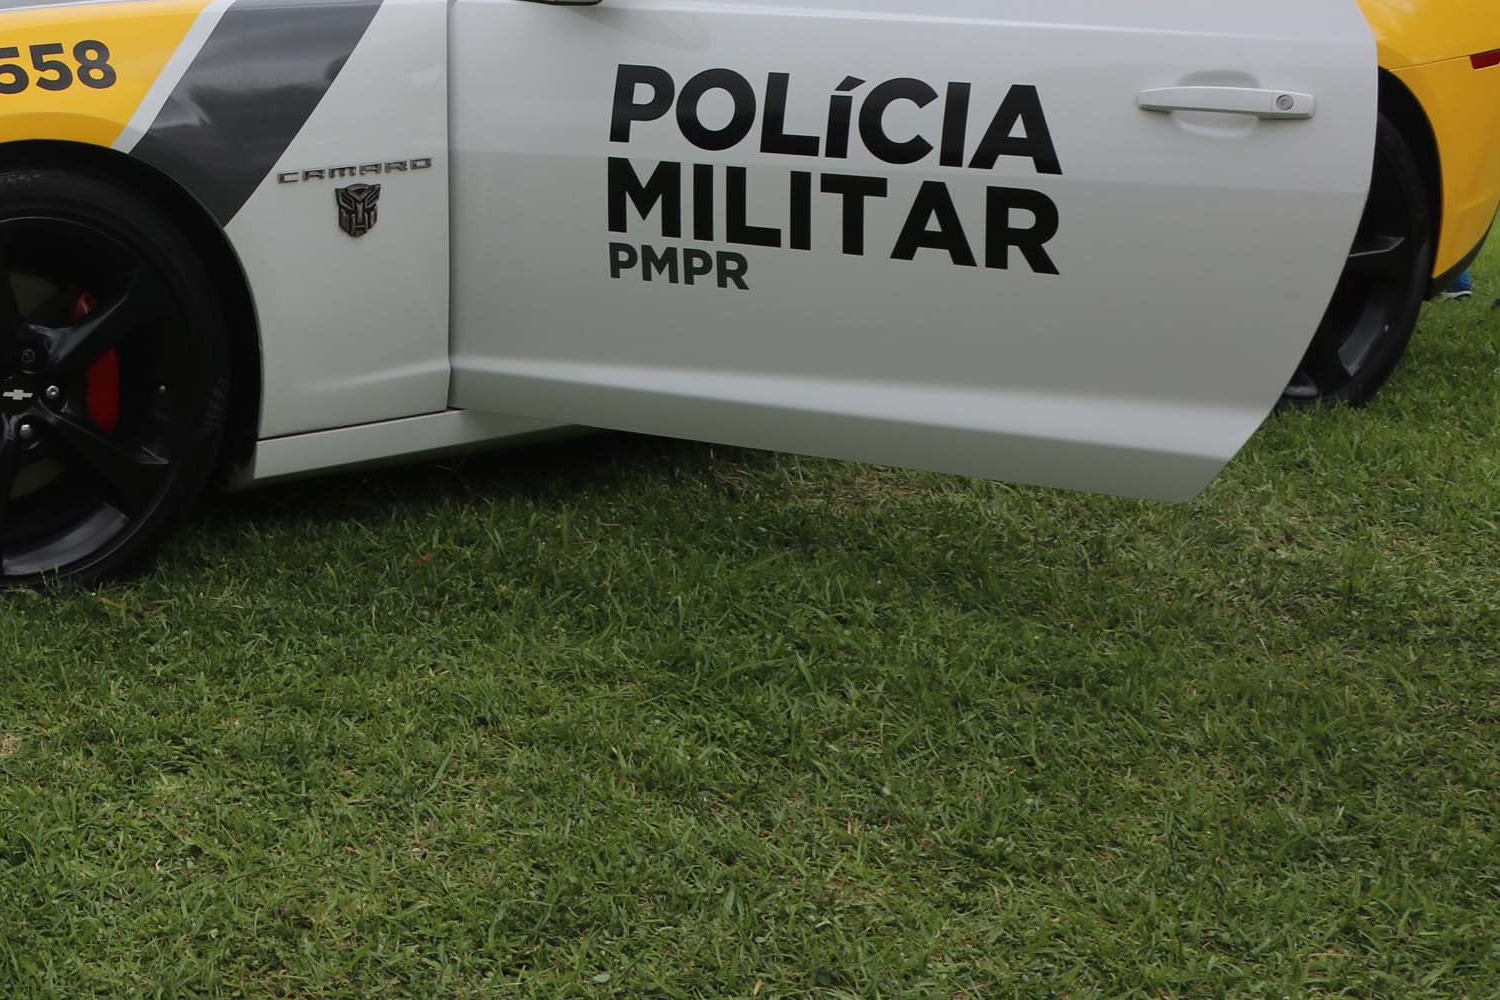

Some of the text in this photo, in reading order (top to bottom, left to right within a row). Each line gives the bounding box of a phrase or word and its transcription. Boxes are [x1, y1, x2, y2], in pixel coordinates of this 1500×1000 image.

[609, 63, 1063, 175] POLÍCIA
[276, 157, 433, 185] CAMARO
[607, 156, 1061, 276] MILITAR
[608, 242, 750, 291] PMPR
